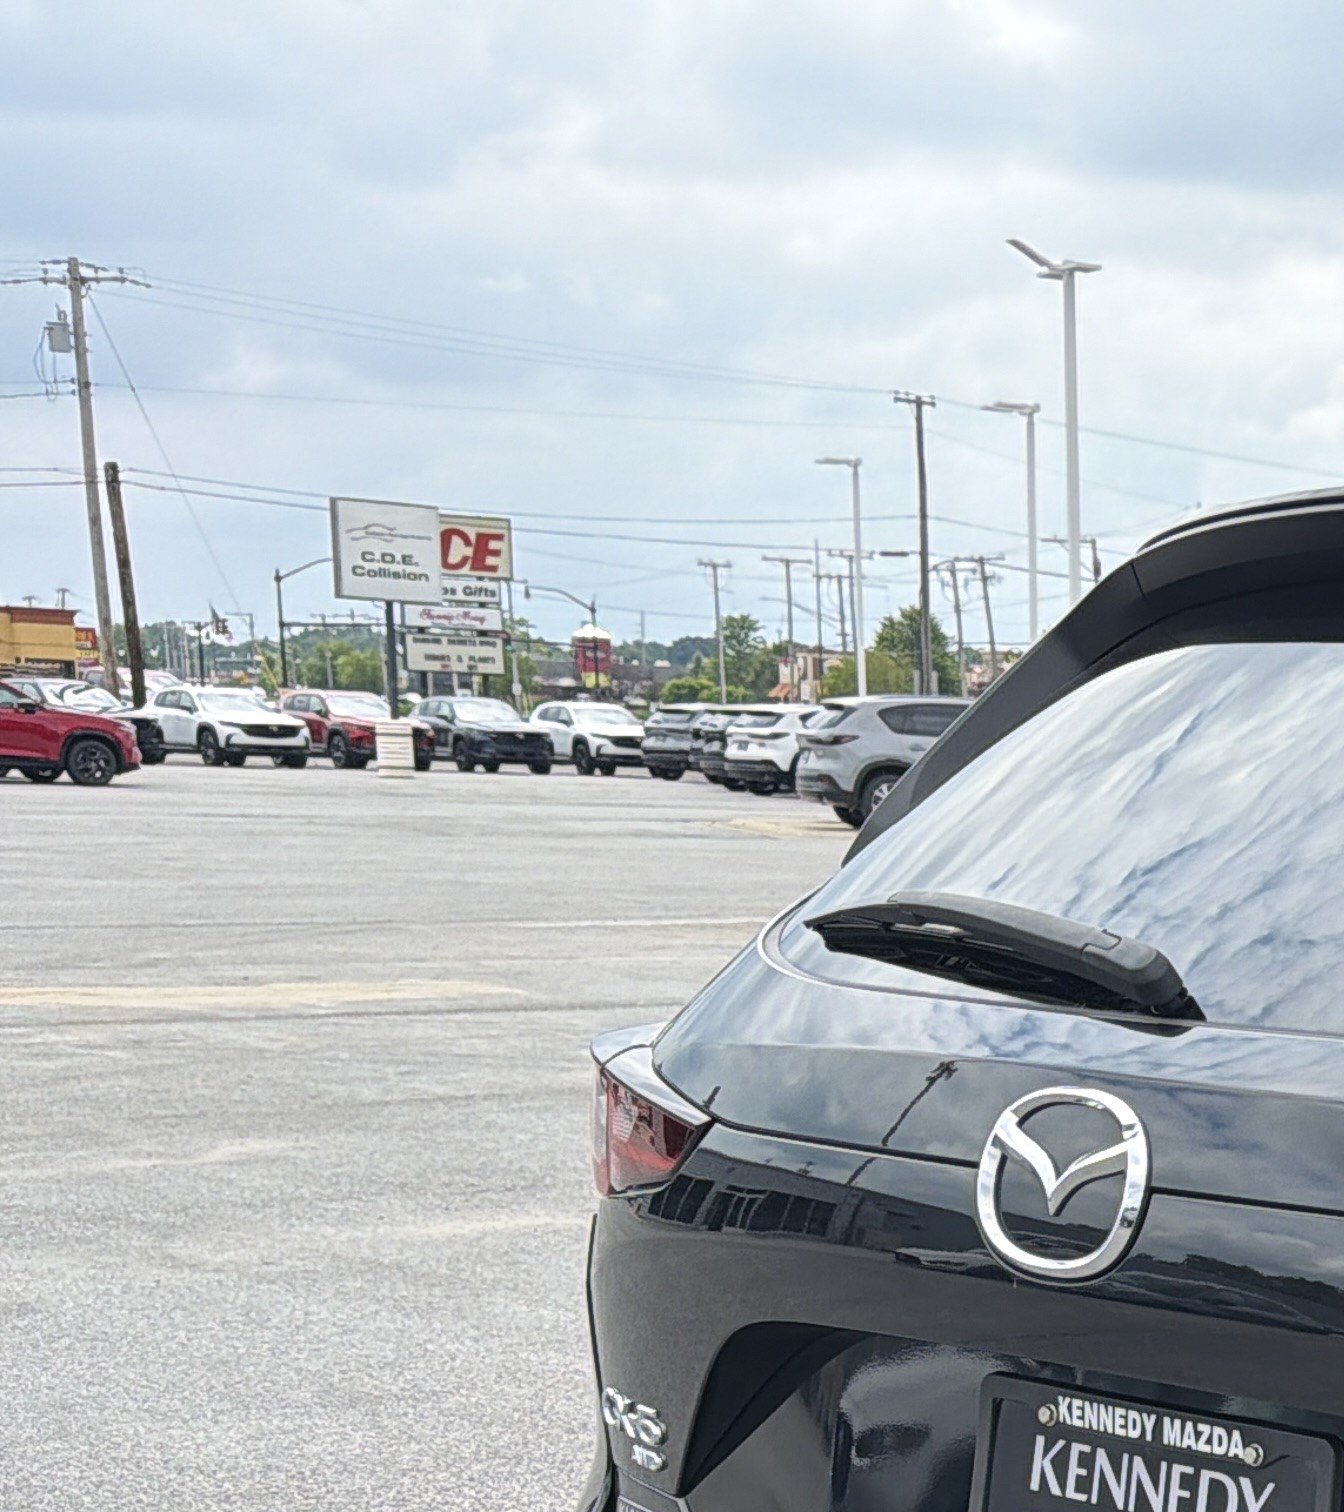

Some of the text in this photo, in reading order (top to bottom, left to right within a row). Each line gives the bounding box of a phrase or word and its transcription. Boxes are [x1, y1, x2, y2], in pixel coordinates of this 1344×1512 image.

[360, 550, 420, 567] C.D.E.
[351, 564, 430, 582] Collision
[462, 585, 496, 598] Gifts
[1057, 1395, 1246, 1460] KENNEDY MAZDA
